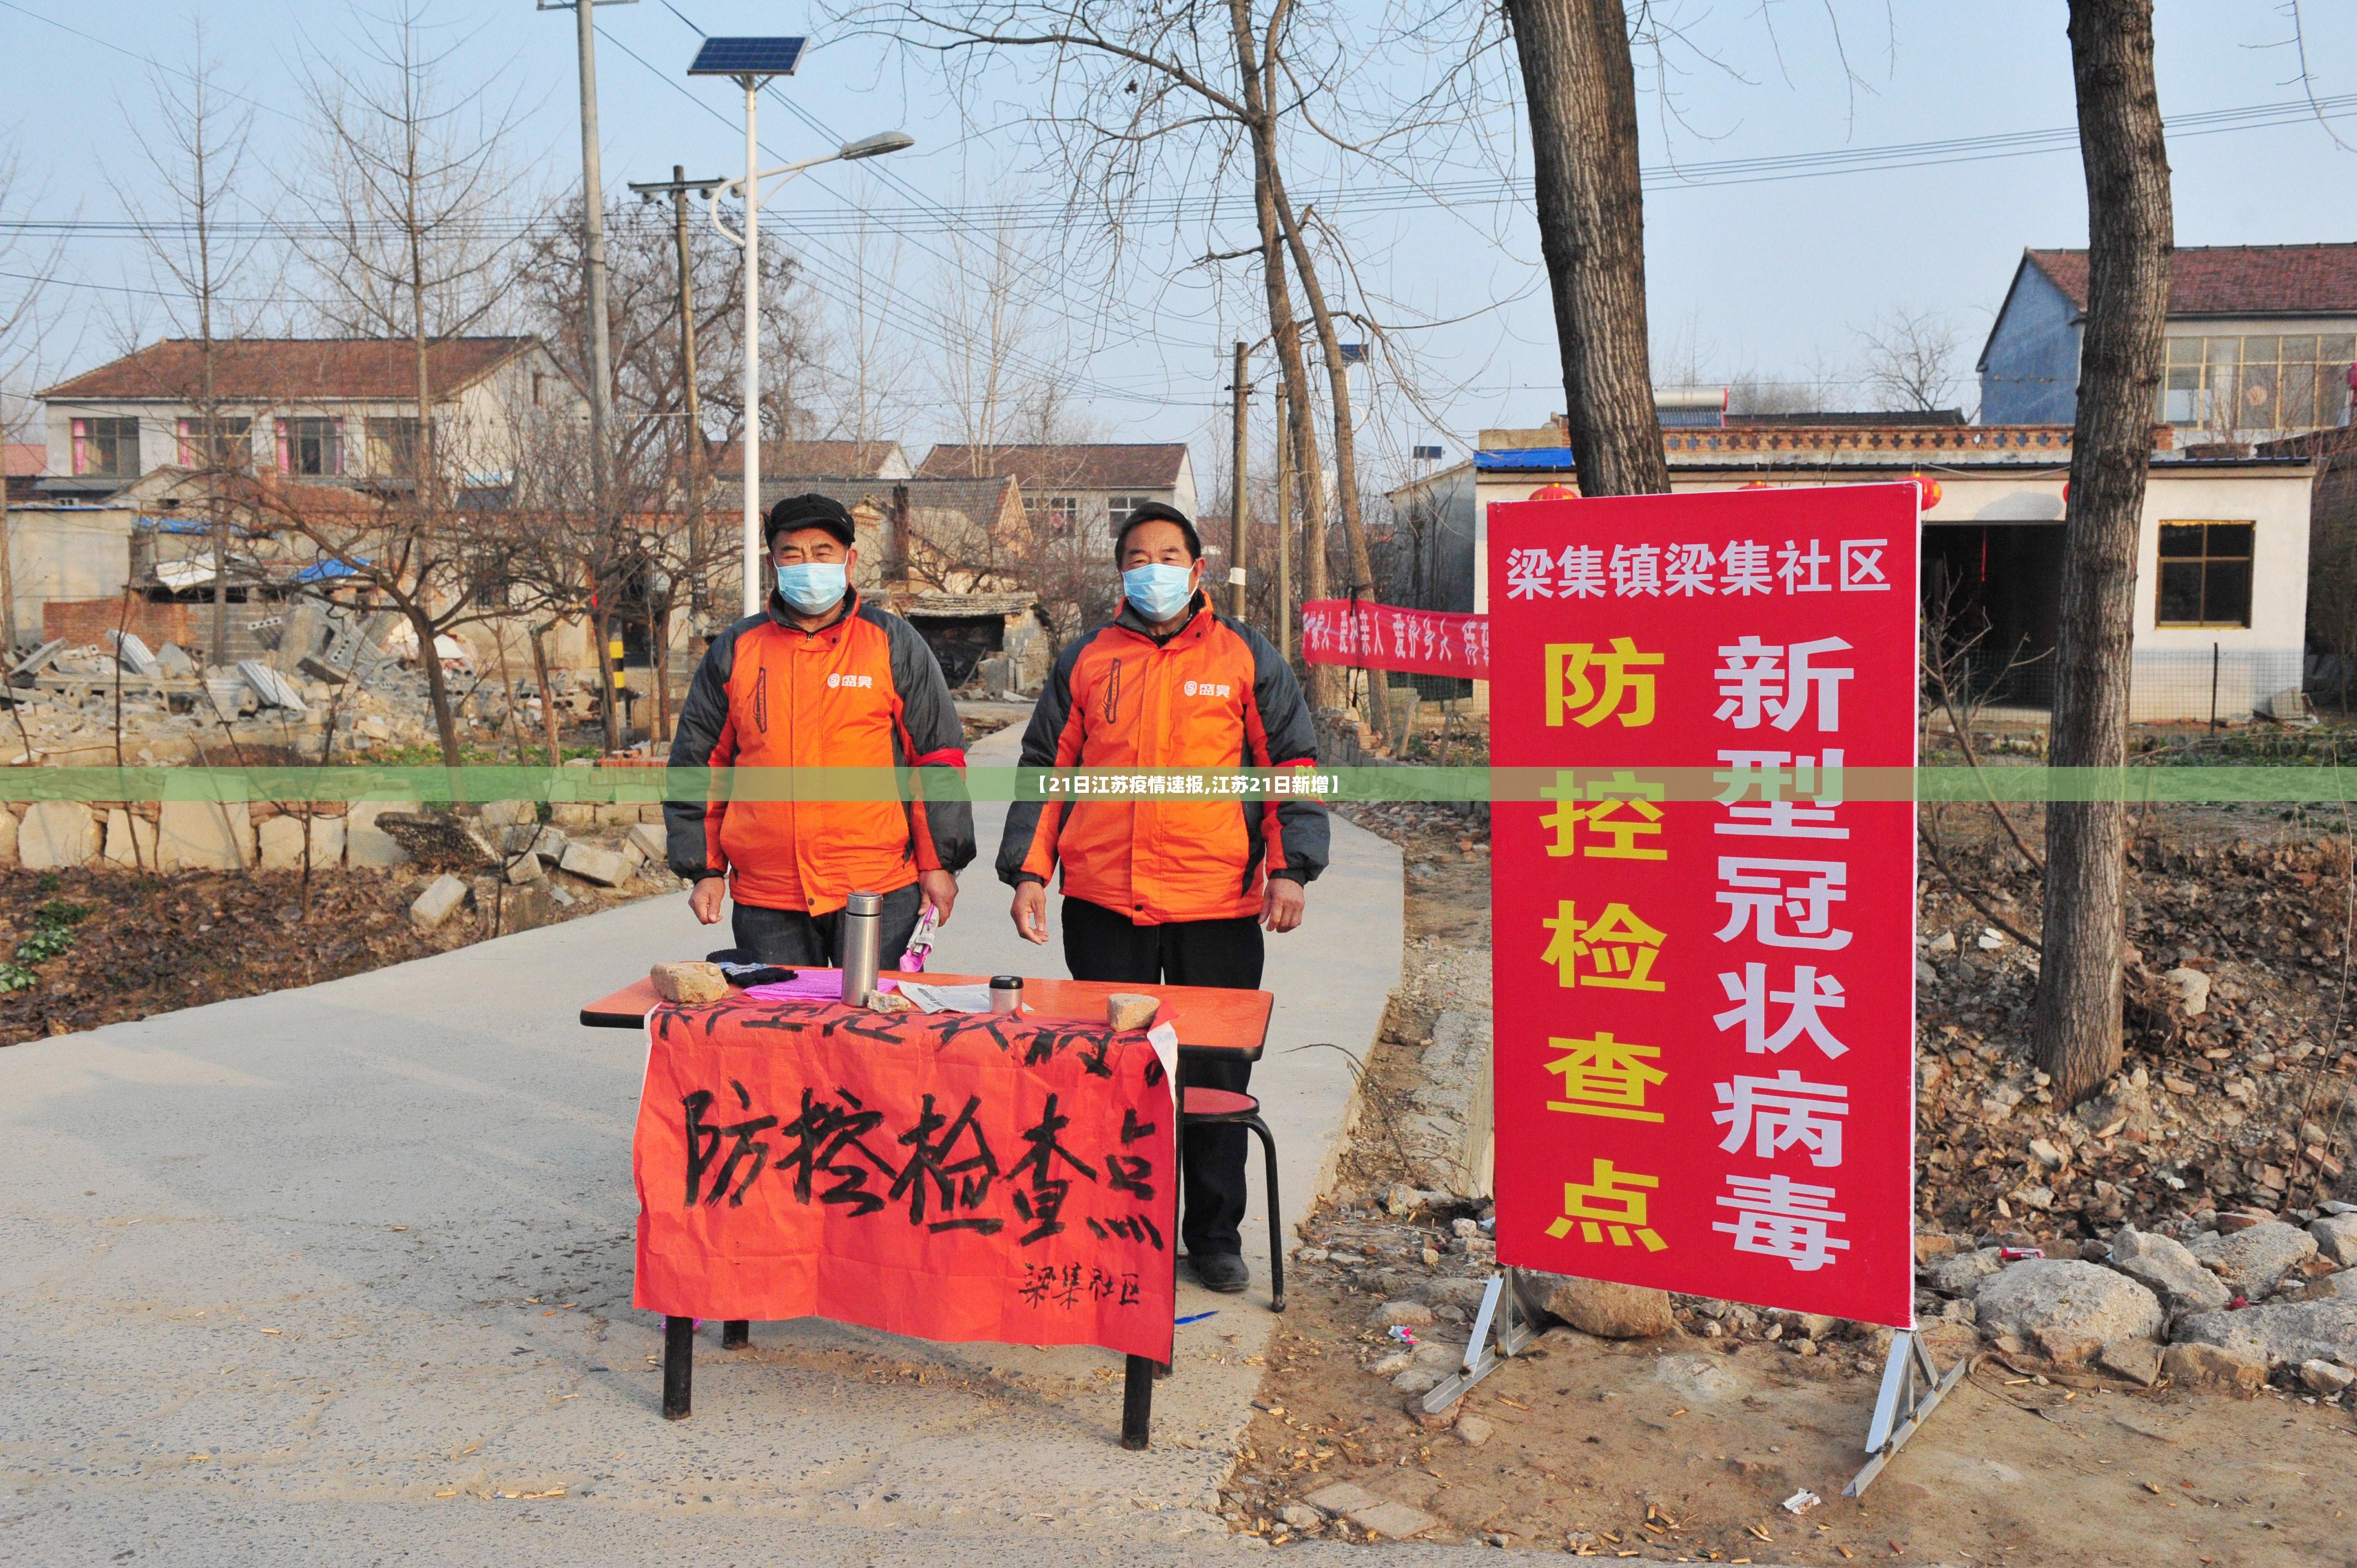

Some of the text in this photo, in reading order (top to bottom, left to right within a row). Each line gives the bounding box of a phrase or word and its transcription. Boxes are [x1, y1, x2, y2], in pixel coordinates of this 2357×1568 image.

[1506, 538, 1891, 600] 梁集镇梁集社区
[1538, 636, 1669, 1252] 防控检查点
[1711, 635, 1854, 1271] 新型冠状病毒
[682, 1077, 1164, 1251] 防控检查点
[1018, 1262, 1139, 1310] 梁集社区
